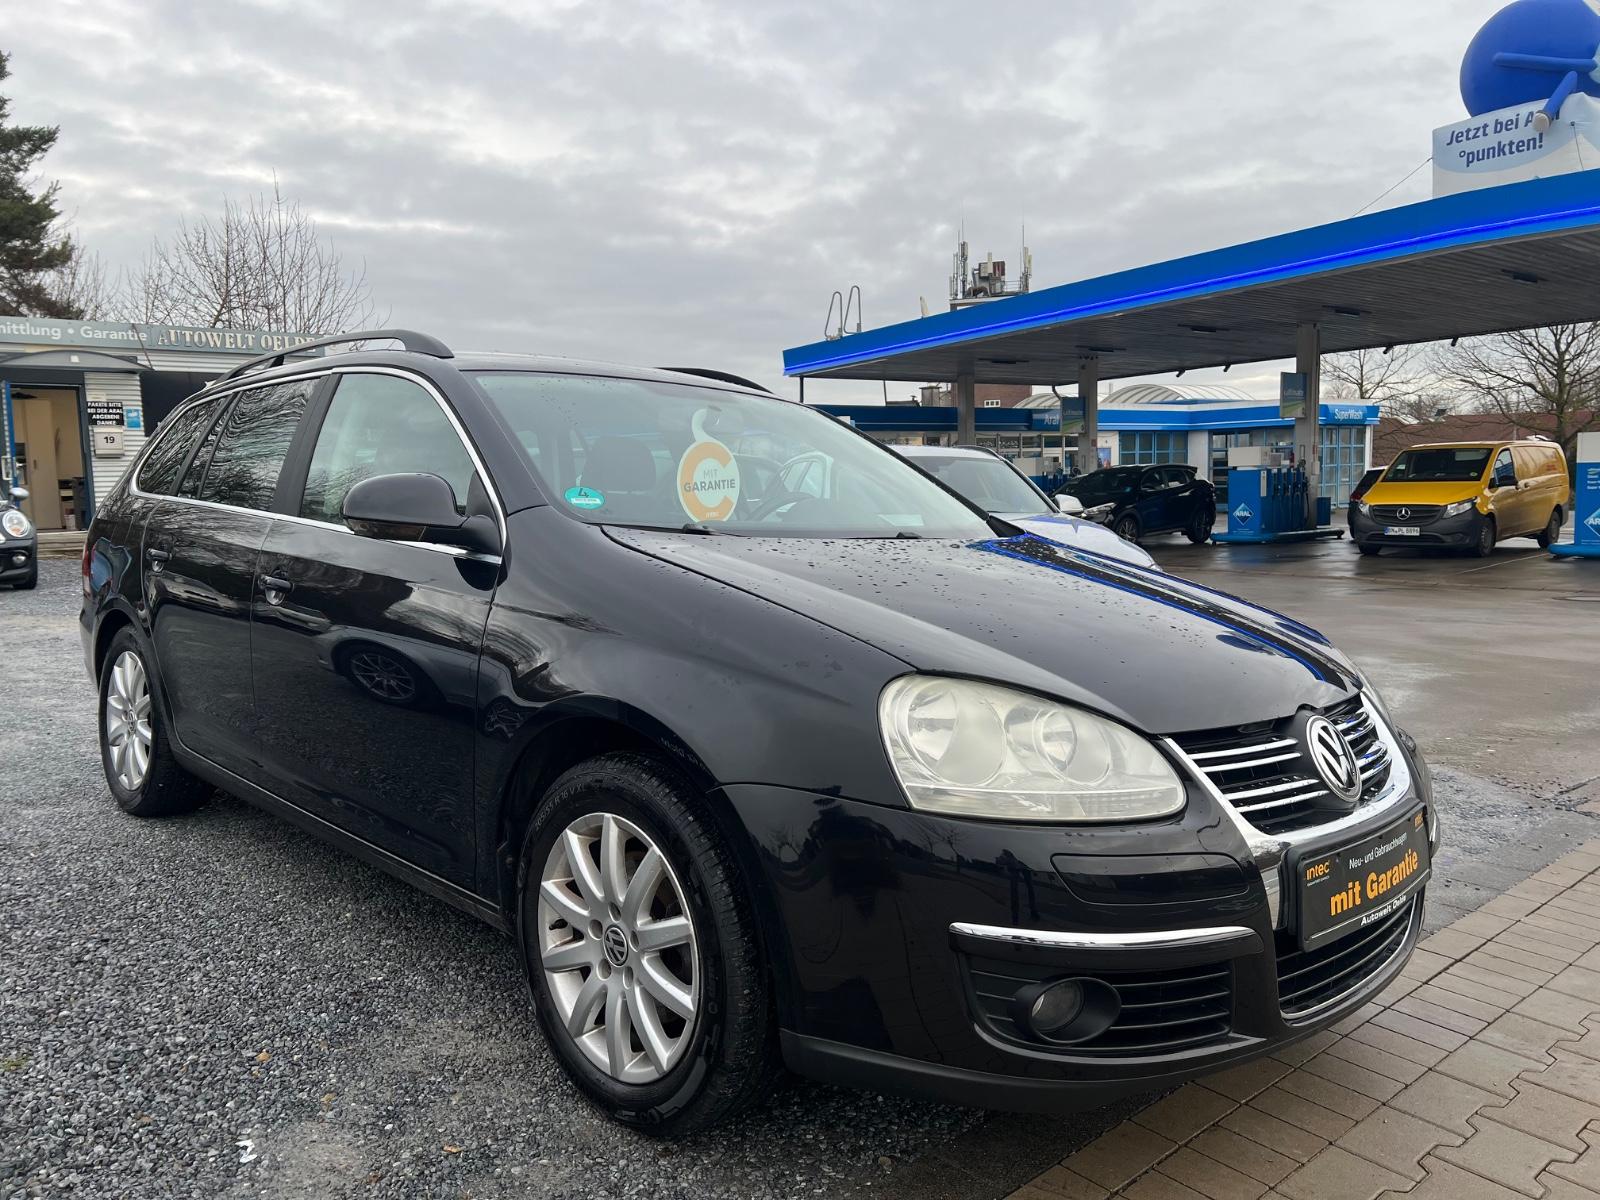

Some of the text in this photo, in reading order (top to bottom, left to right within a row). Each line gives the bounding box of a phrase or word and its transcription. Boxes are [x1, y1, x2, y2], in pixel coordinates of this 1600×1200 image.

[1446, 122, 1489, 146] Jetzt
[1493, 113, 1520, 134] bei
[80, 325, 148, 341] Garantie
[158, 329, 255, 350] AUTOWELT
[1044, 414, 1059, 425] Aral
[1334, 408, 1363, 421] SuperWash
[103, 436, 115, 444] 19
[703, 469, 718, 479] MIT
[684, 479, 736, 492] GARANTIE
[1349, 832, 1408, 869] Neu- und Gebrauchtwagen
[1330, 849, 1418, 916] mit Garantie
[1360, 903, 1392, 926] Autowelt
